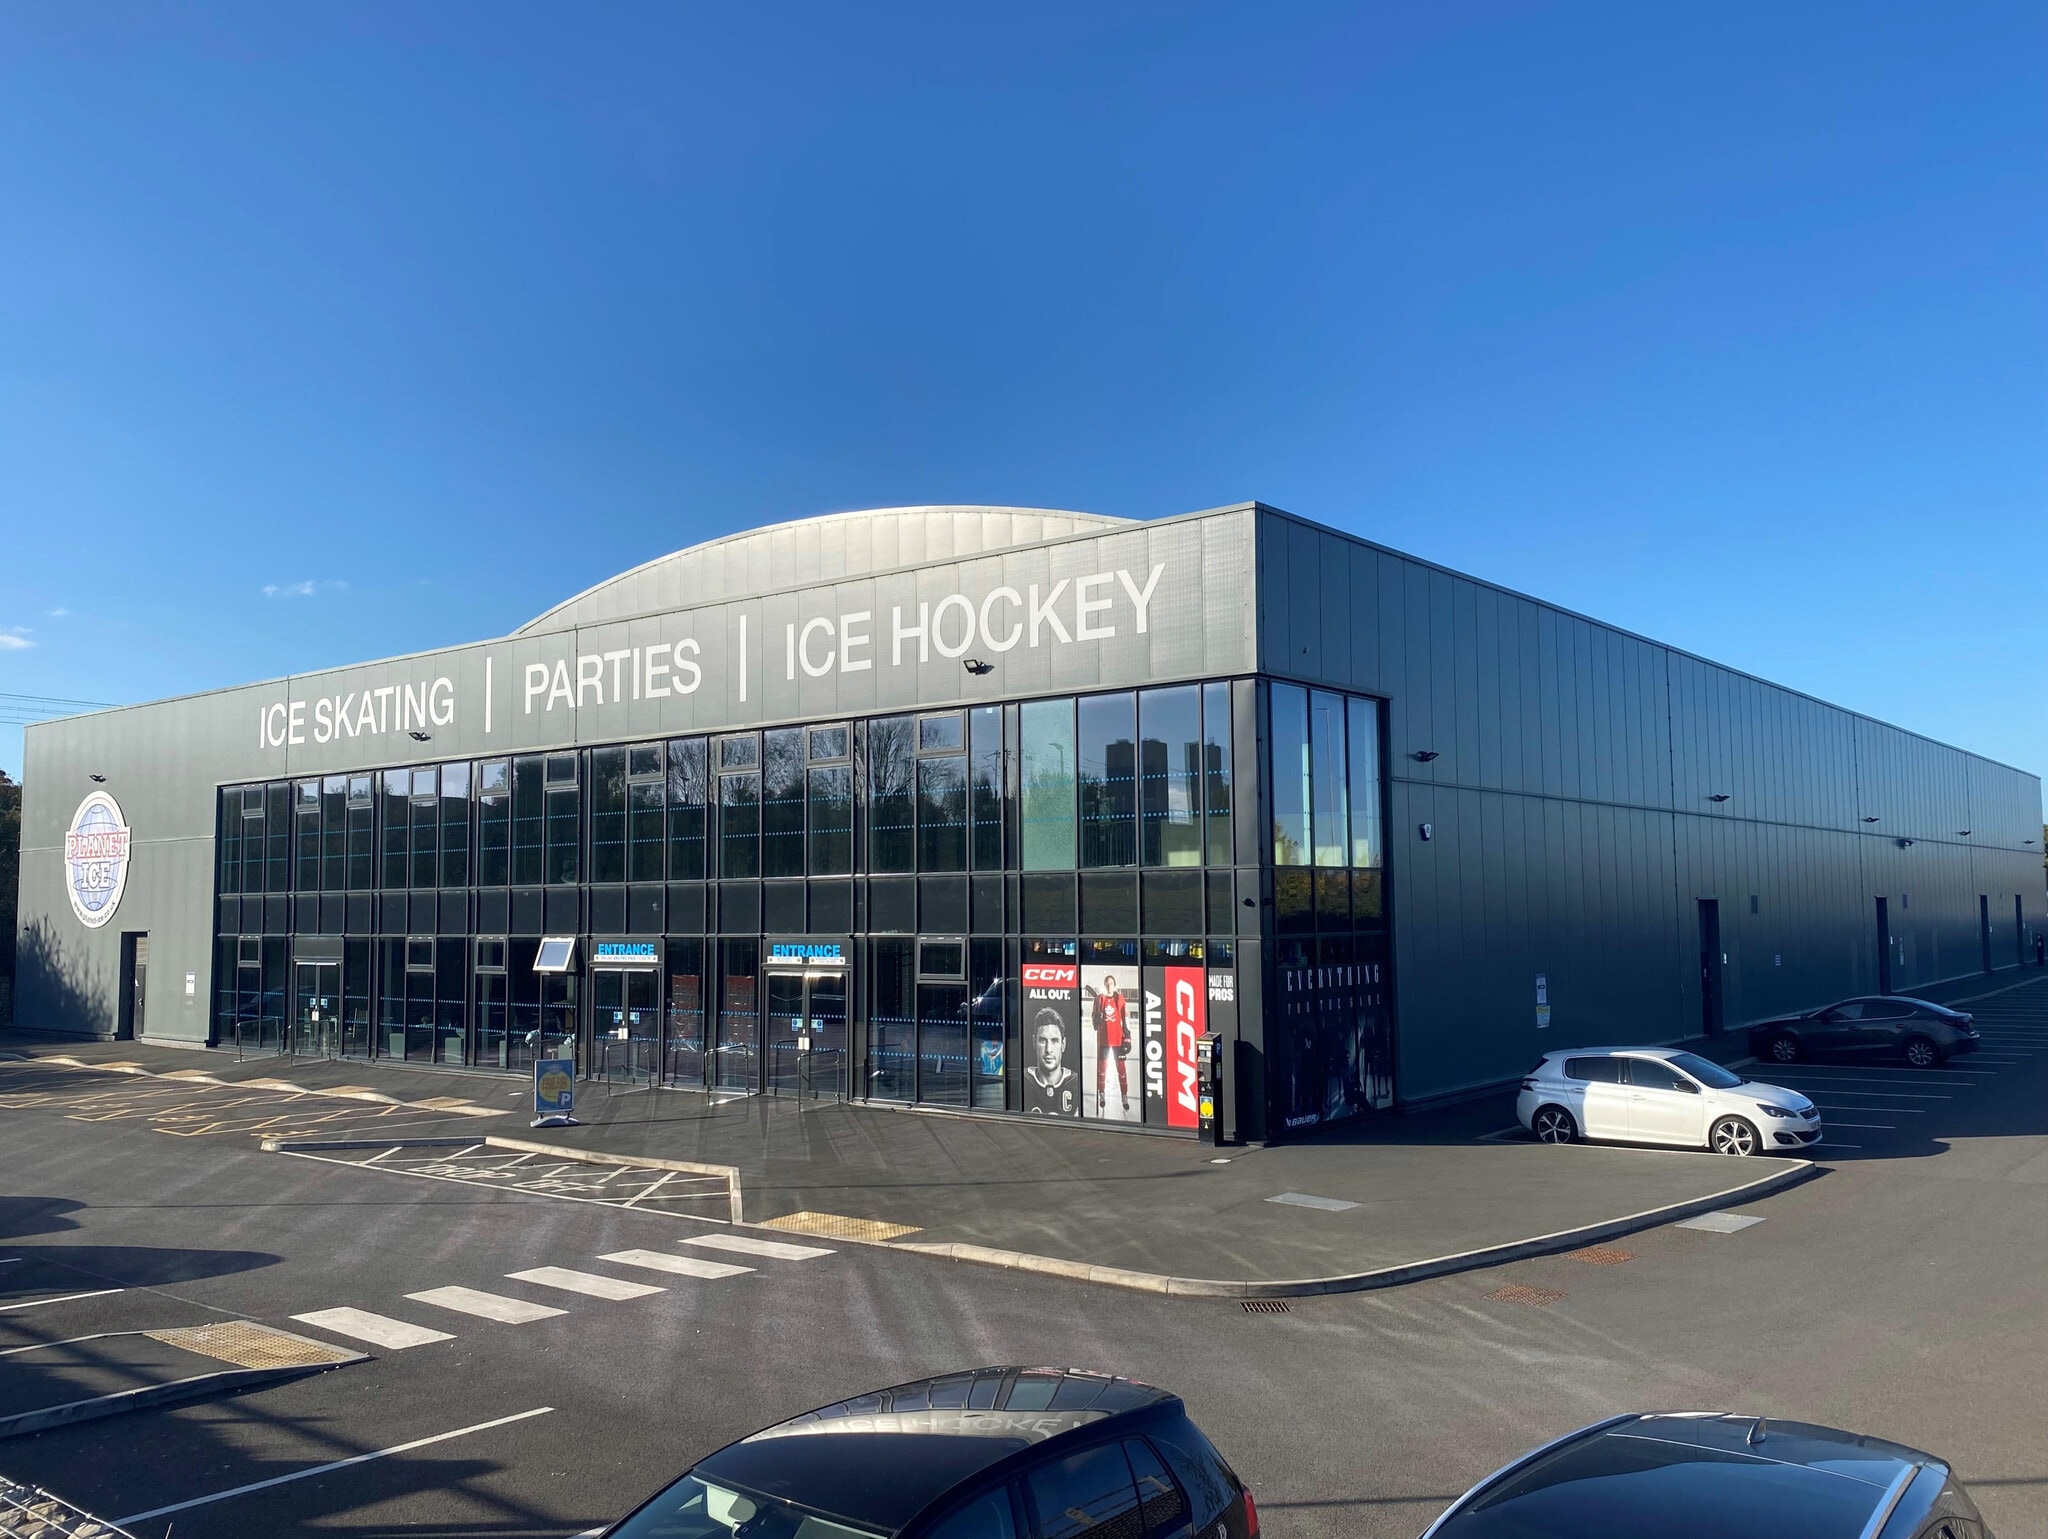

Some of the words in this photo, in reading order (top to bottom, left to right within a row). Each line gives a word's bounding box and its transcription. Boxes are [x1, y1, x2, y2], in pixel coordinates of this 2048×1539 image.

[259, 700, 306, 749] ICE
[313, 676, 455, 744] SKATING
[524, 638, 702, 715] PARTIES
[786, 610, 872, 680] ICE
[892, 562, 1167, 666] HOCKEY
[67, 831, 128, 859] PLANET
[81, 861, 111, 889] ICE
[598, 943, 655, 956] ENTRANCE
[772, 944, 841, 957] ENTRANCE
[1024, 968, 1075, 981] CCM
[1209, 974, 1222, 988] MADE
[1223, 975, 1233, 988] FOR
[1287, 964, 1379, 992] EVERYTHING
[1029, 988, 1047, 999] ALL
[1048, 989, 1071, 1000] OUT.
[1209, 988, 1234, 1001] PROS
[1145, 990, 1162, 1037] ALL
[1176, 979, 1197, 1113] CCM
[1145, 1040, 1163, 1098] OUT.
[560, 1093, 571, 1106] P
[1062, 1090, 1073, 1112] C
[406, 1164, 516, 1179] DROP
[512, 1179, 607, 1193] OFF
